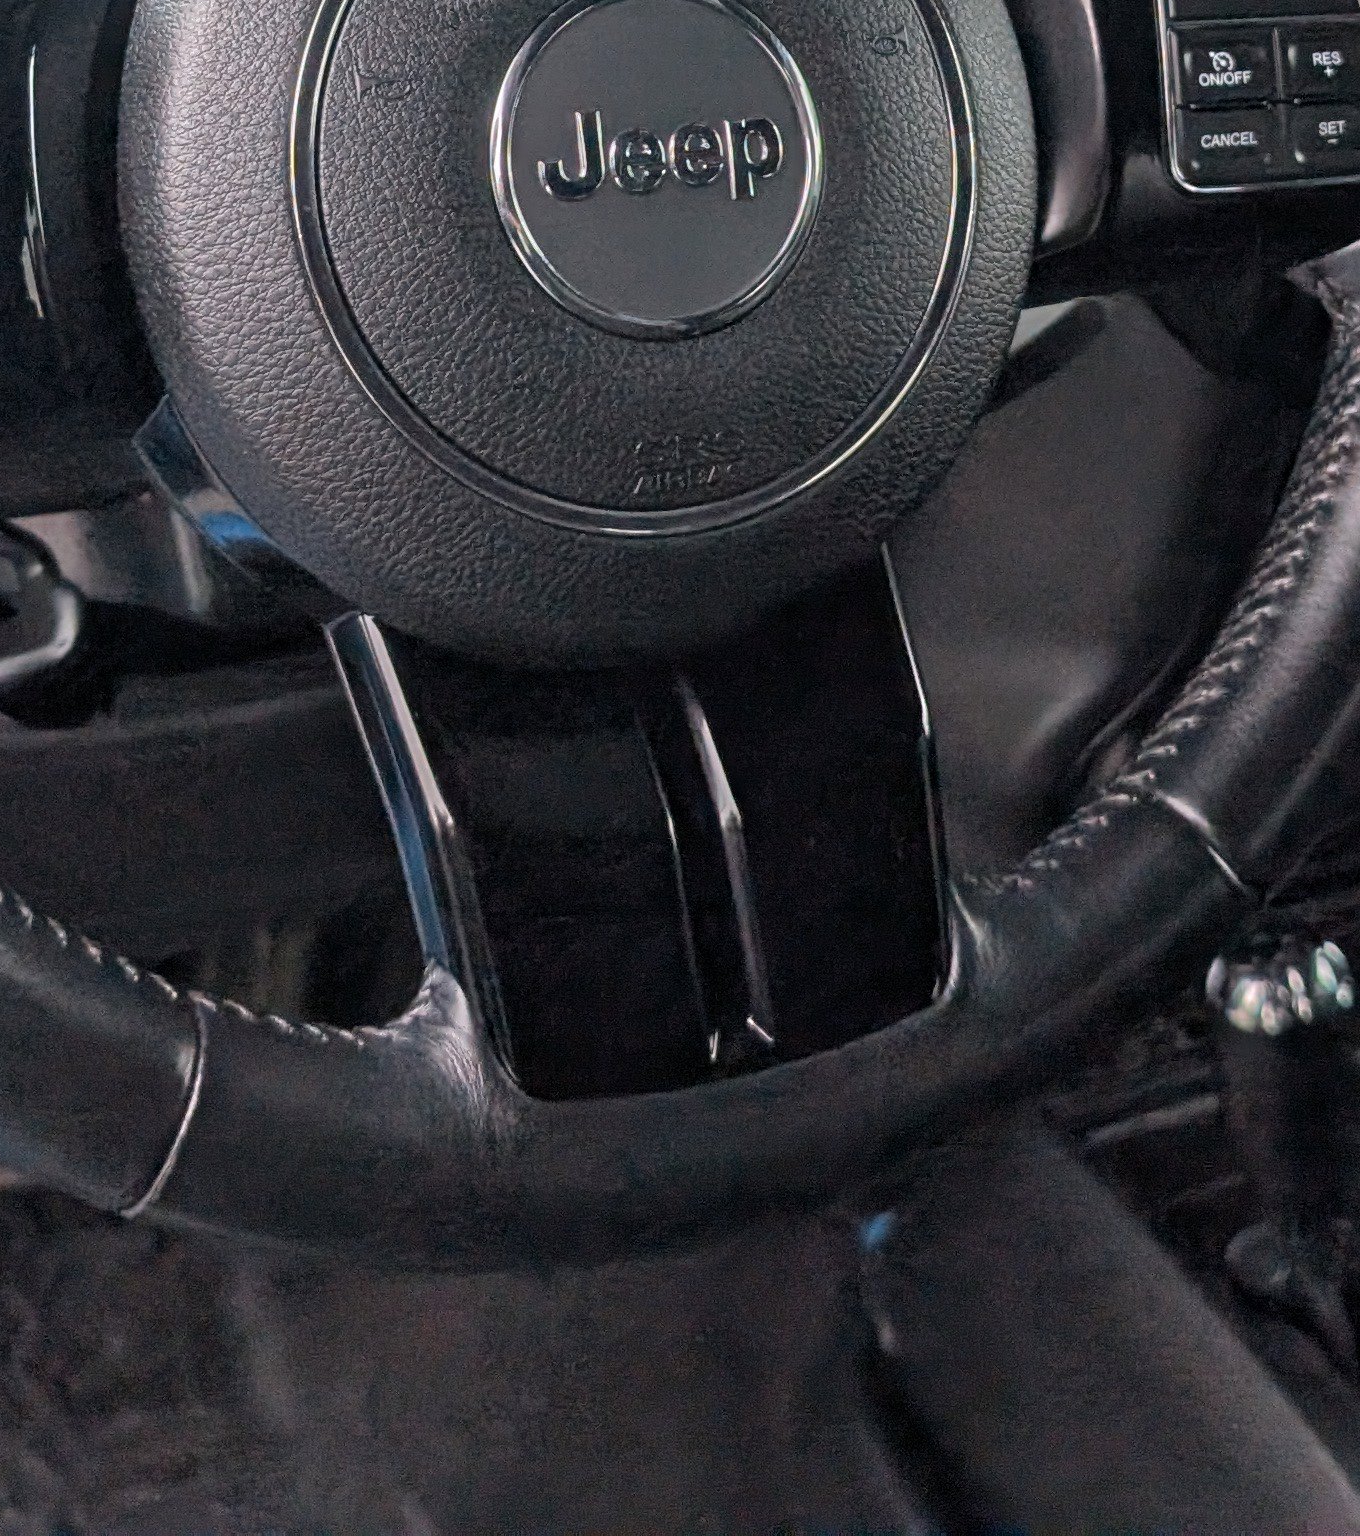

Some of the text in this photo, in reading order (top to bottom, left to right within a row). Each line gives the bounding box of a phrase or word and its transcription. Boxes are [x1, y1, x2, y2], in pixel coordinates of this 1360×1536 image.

[1312, 51, 1342, 66] RES
[1198, 70, 1252, 87] ON/OFF
[1318, 120, 1346, 136] SET
[1200, 131, 1258, 149] CANCEL
[538, 109, 784, 202] Jeep
